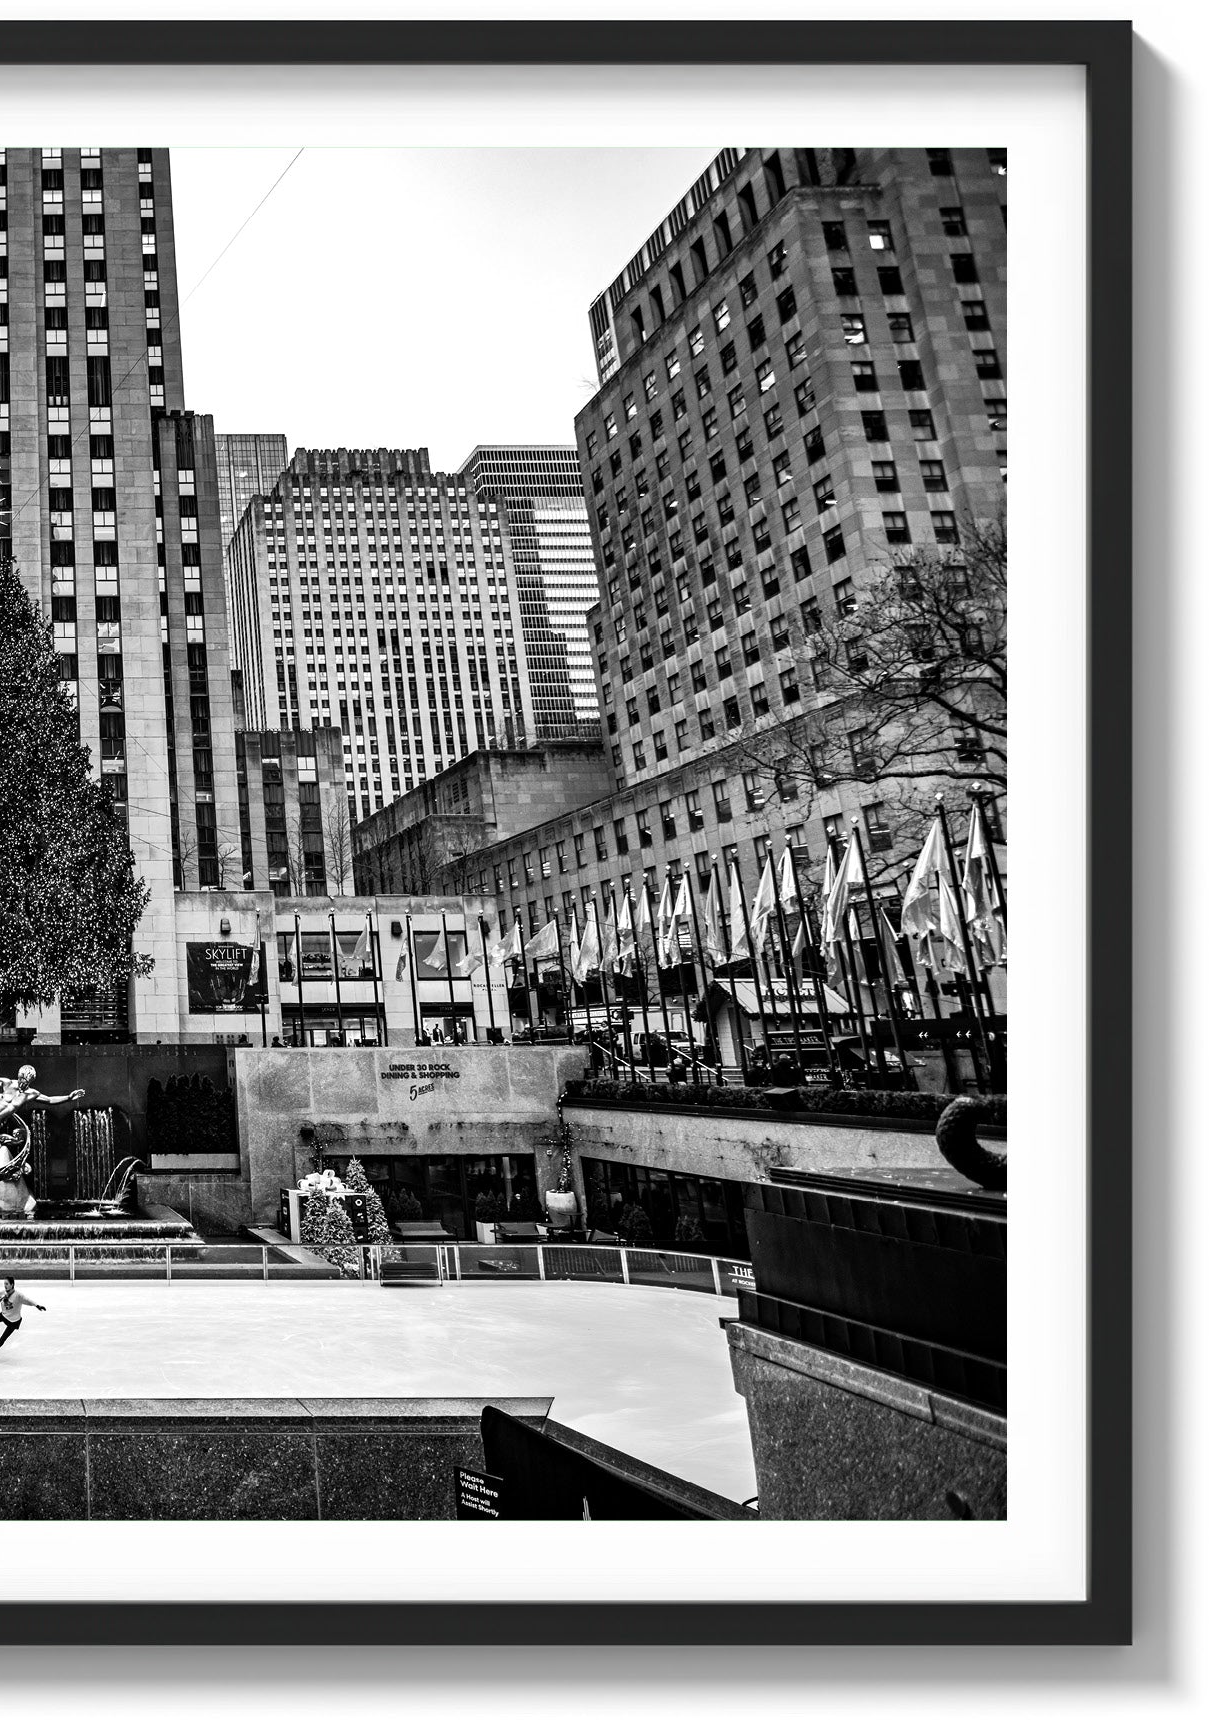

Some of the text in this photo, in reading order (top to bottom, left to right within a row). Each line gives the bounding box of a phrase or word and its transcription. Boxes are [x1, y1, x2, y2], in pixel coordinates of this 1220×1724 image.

[205, 948, 247, 960] SKYLIFT
[409, 1085, 418, 1101] 5
[732, 1265, 754, 1278] THE
[460, 1471, 484, 1484] Please
[460, 1480, 499, 1498] Wait Here
[466, 1493, 479, 1503] Host
[461, 1499, 499, 1518] Assist Shortly
